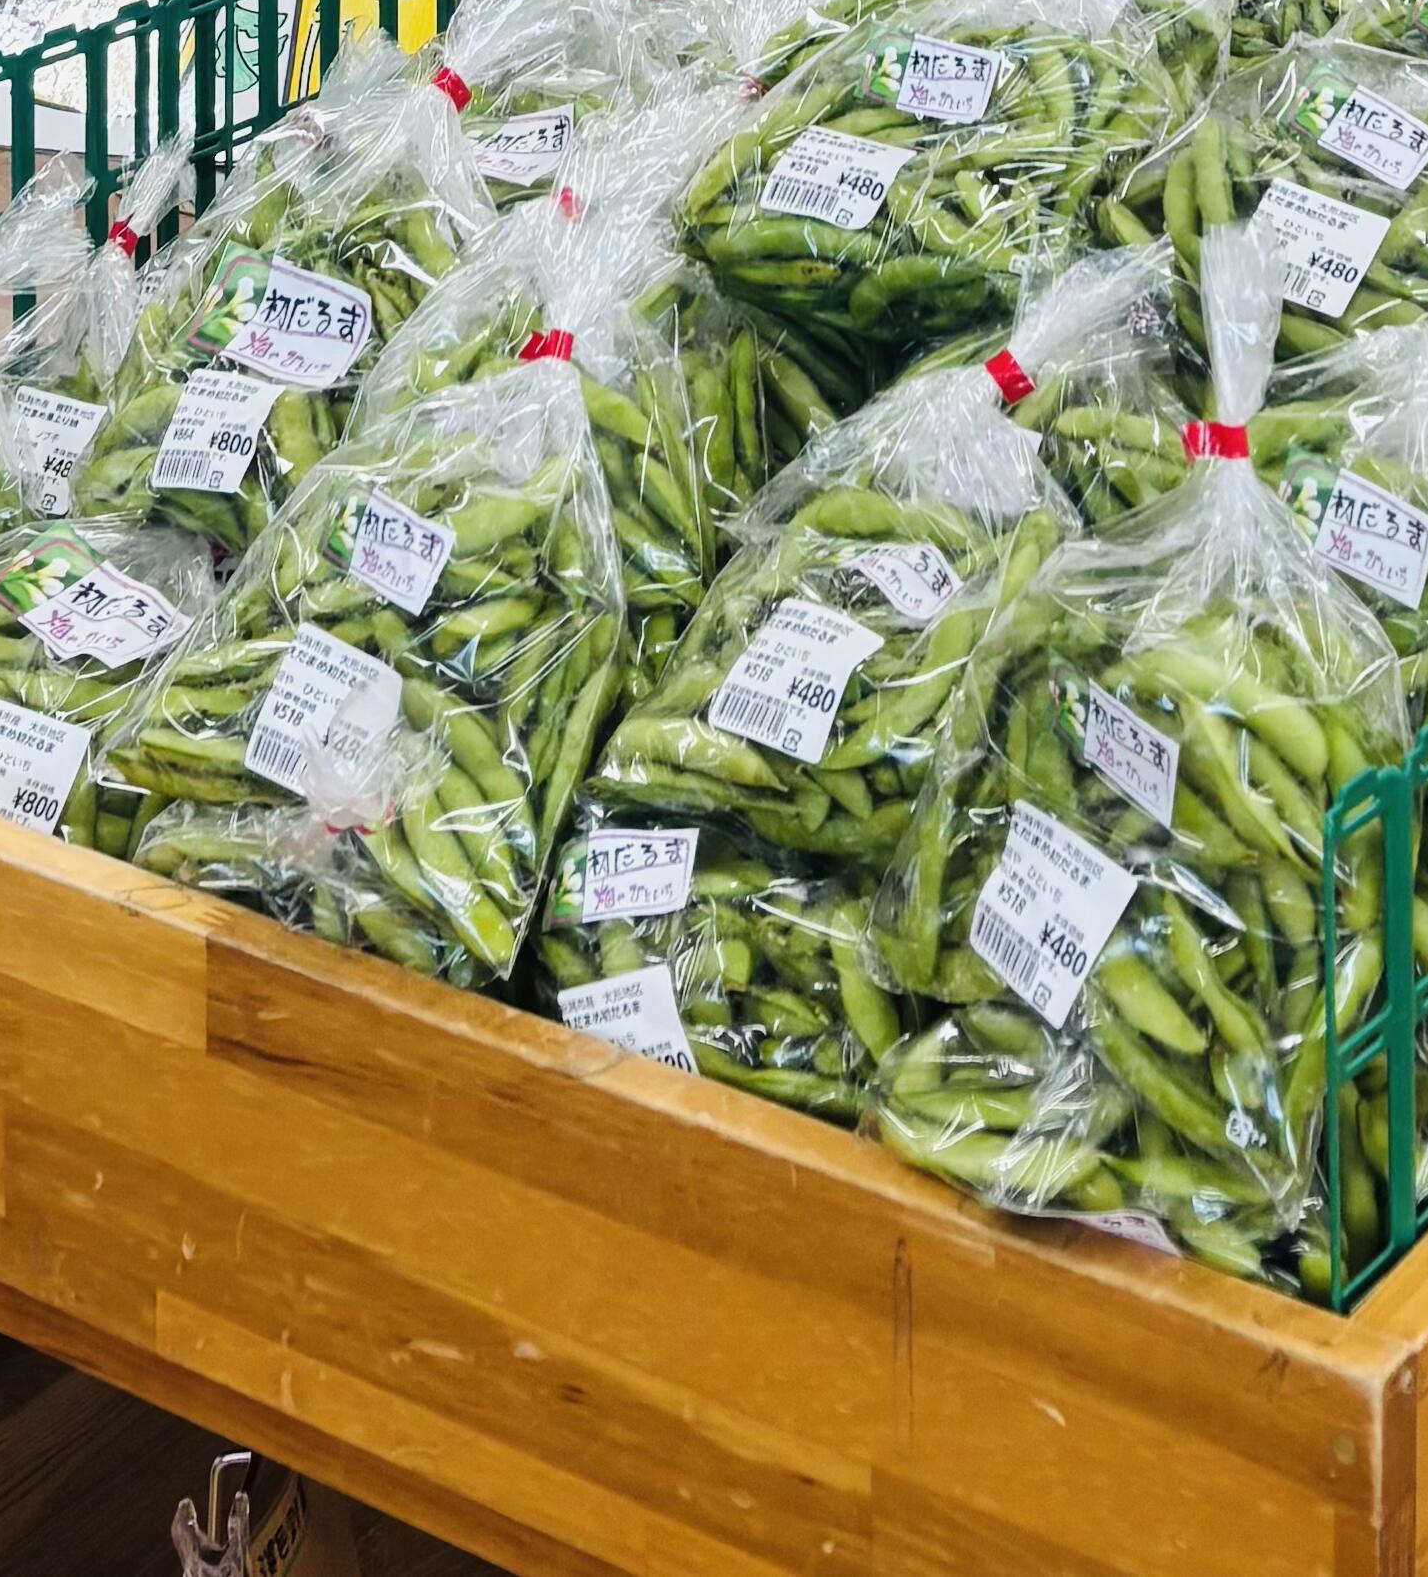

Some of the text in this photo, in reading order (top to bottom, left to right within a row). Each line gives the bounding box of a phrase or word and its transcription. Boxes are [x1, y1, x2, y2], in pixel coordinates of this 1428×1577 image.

[910, 49, 990, 84] 初だるま
[837, 171, 884, 201] ¥480
[1308, 251, 1359, 284] ¥480
[258, 288, 363, 344] 初だるま
[209, 431, 253, 457] ¥800
[42, 455, 73, 479] ¥48
[1330, 485, 1428, 552] 初だるま
[743, 662, 773, 683] ¥518
[786, 675, 836, 714] ¥480
[273, 703, 305, 727] ¥518
[12, 786, 60, 822] ¥800
[588, 838, 686, 876] 初だるま
[996, 882, 1028, 917] ¥518
[1038, 920, 1088, 978] ¥480
